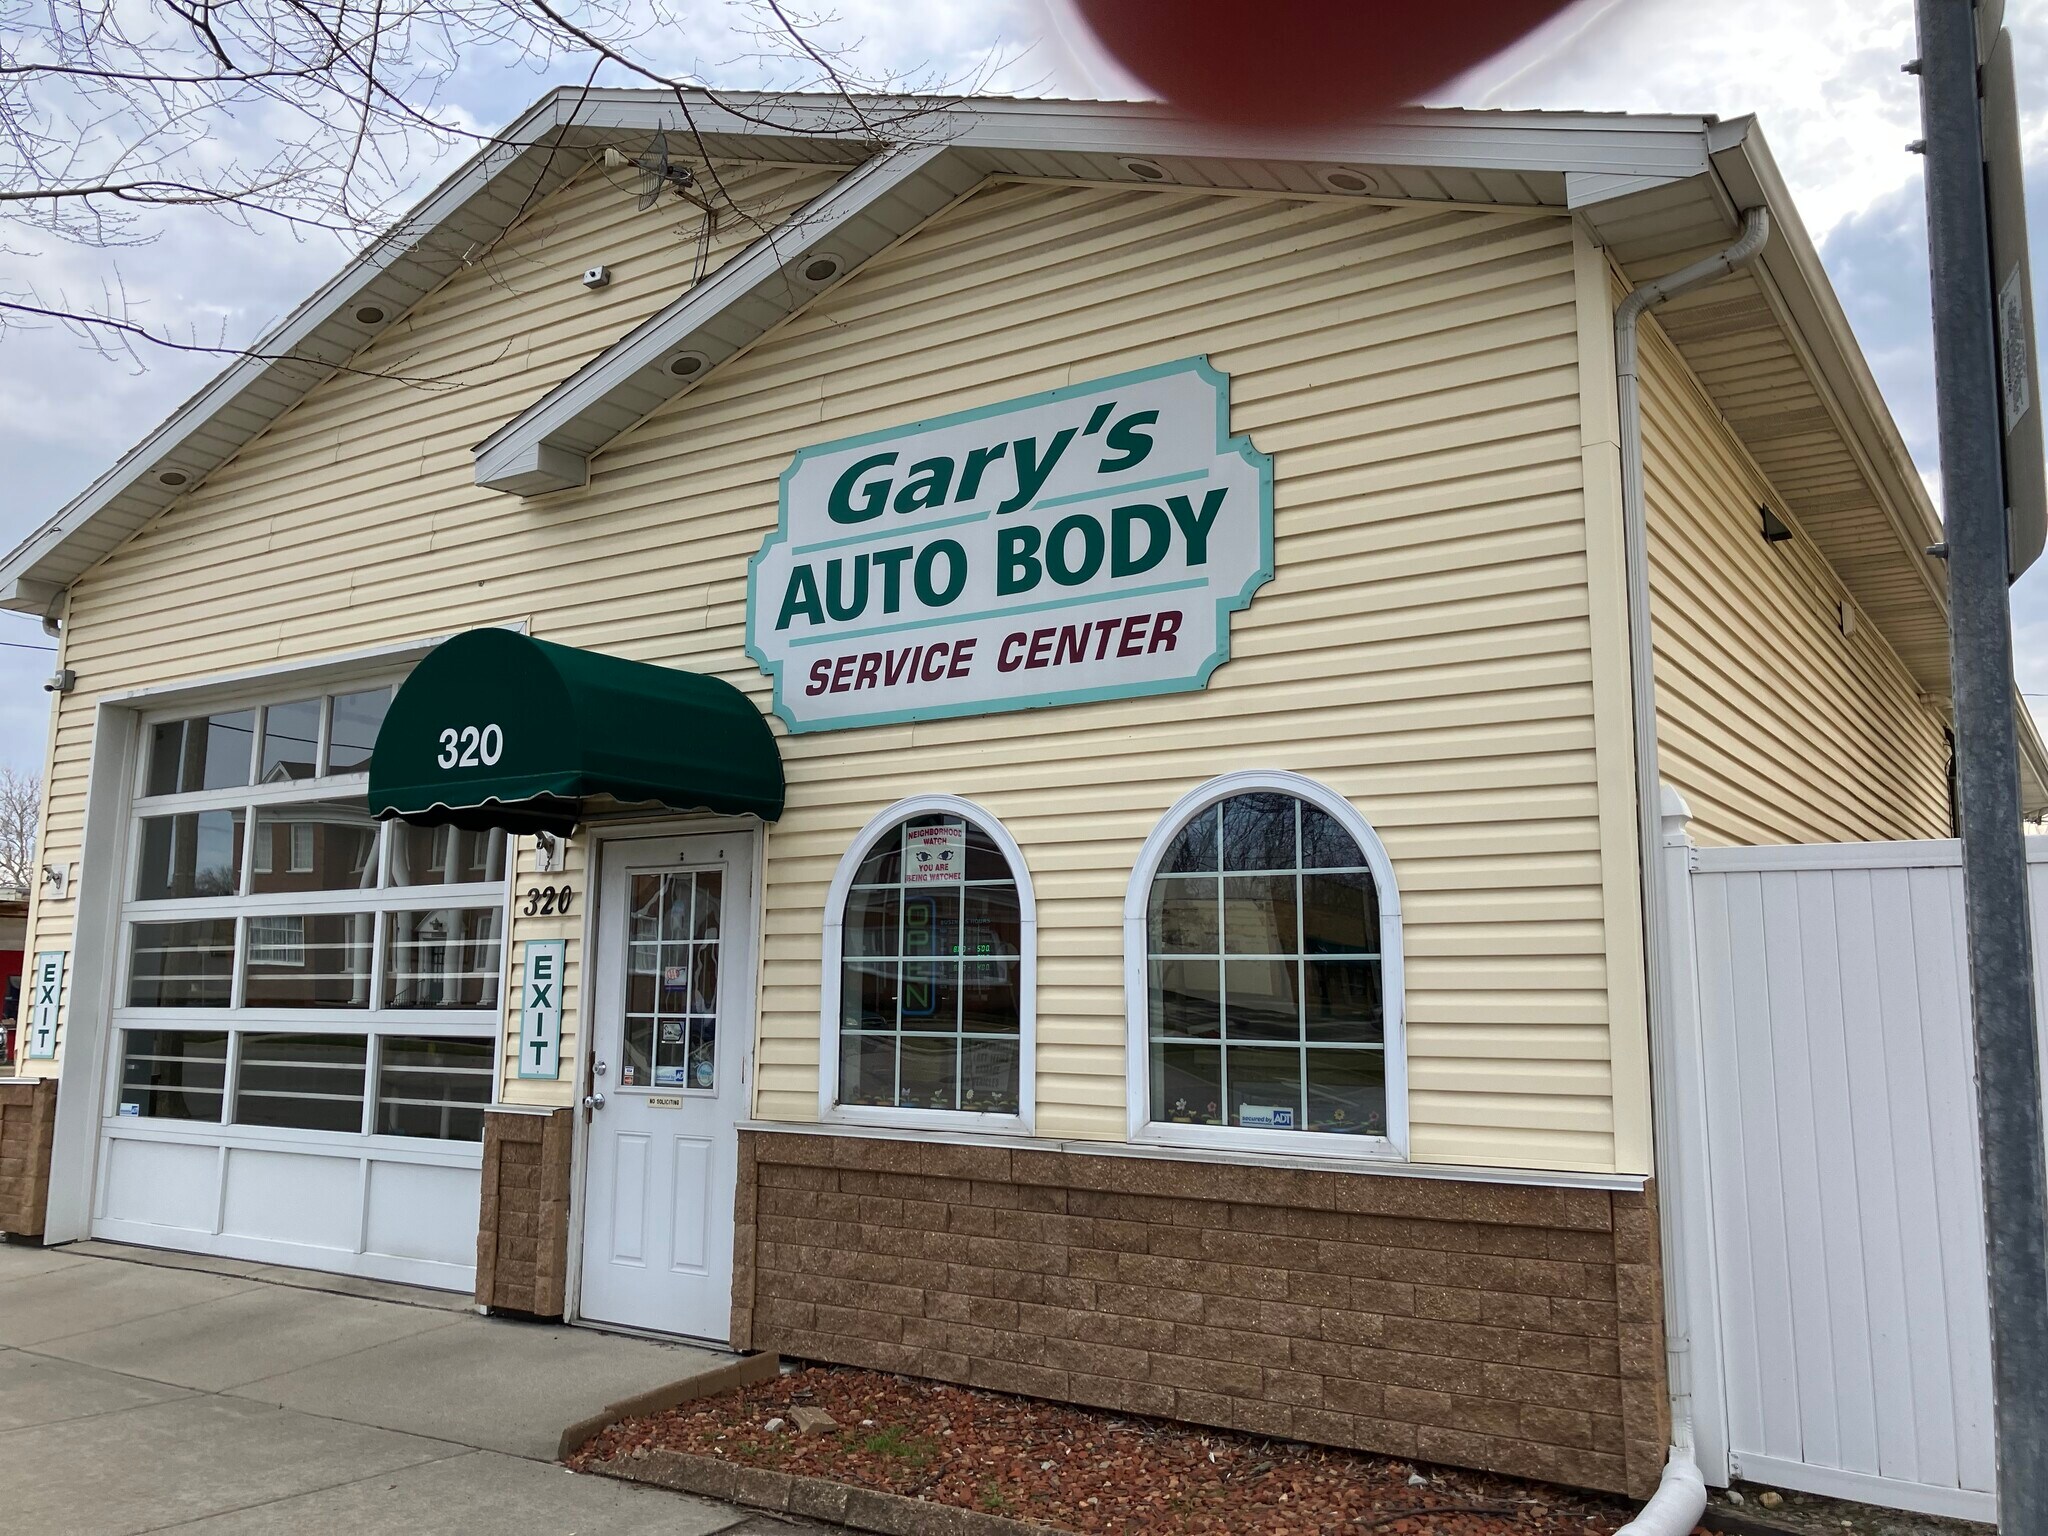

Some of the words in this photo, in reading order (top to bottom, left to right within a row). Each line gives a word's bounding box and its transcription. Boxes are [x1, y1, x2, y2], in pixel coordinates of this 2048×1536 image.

[828, 401, 1159, 524] Gary's
[775, 538, 968, 631] AUTO
[996, 487, 1229, 596] BODY
[805, 638, 977, 696] SERVICE
[997, 610, 1183, 672] CENTER
[437, 723, 504, 769] 320
[523, 884, 573, 917] 320
[906, 904, 929, 1008] OPEN
[38, 964, 56, 1048] EXIT
[529, 955, 552, 1066] EXIT
[1266, 1116, 1272, 1124] by
[1274, 1112, 1291, 1124] ADT
